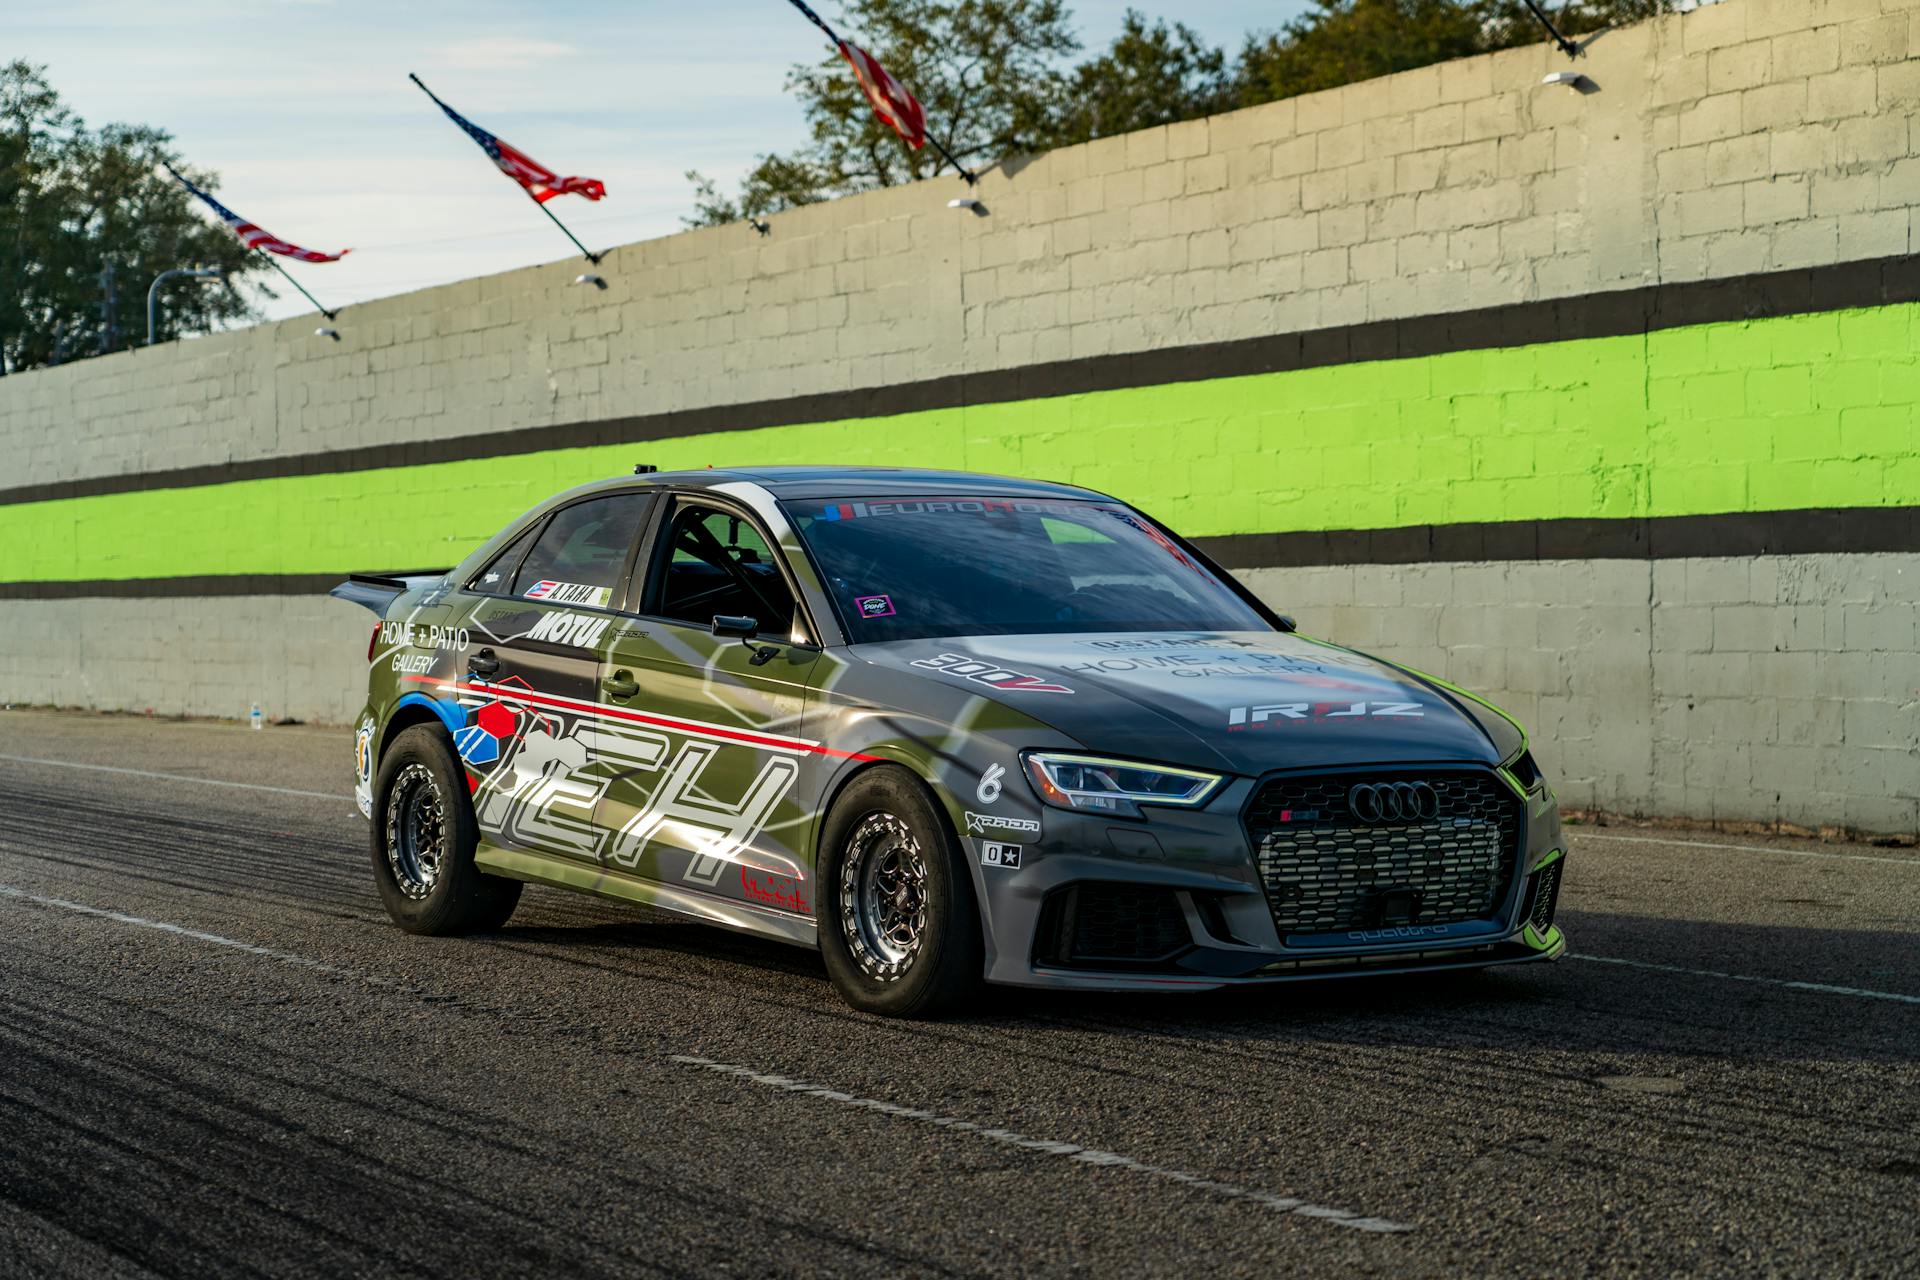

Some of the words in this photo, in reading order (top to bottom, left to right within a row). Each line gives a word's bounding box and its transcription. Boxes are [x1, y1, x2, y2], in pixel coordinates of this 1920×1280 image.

[380, 622, 415, 646] HOME
[428, 625, 469, 652] PATIO
[526, 611, 611, 649] MOTUL
[392, 654, 439, 673] GALLERY
[1060, 654, 1210, 674] HOME
[1245, 653, 1376, 668] PATIO
[1171, 666, 1326, 678] GALLERY
[1348, 925, 1448, 942] quattro
